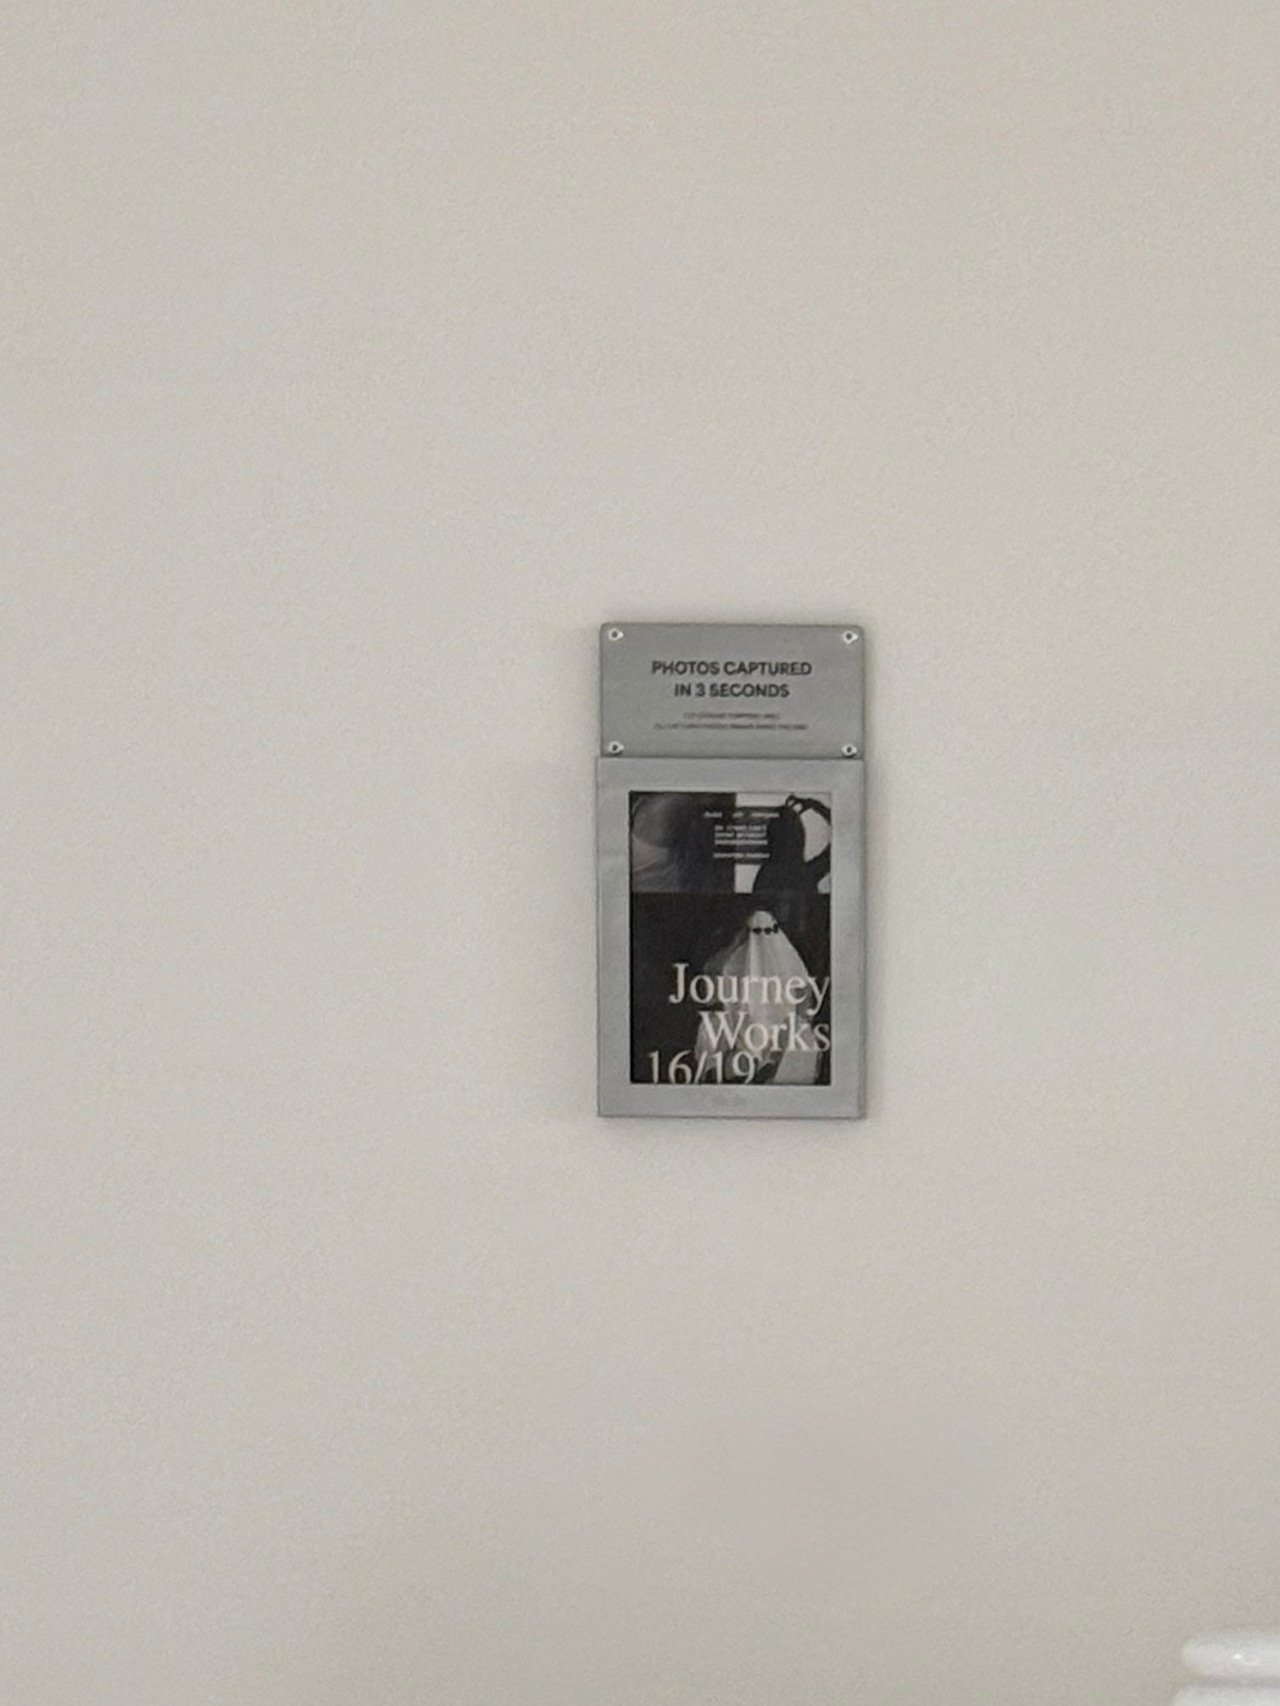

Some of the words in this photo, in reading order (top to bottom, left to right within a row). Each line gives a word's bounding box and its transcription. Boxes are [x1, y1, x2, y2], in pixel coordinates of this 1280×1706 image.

[652, 660, 720, 676] PHOTOS
[724, 660, 812, 676] CAPTURED
[674, 682, 692, 697] IN
[695, 683, 706, 698] 3
[710, 683, 790, 698] SECONDS
[669, 962, 830, 1016] Journey
[698, 1010, 831, 1051] Works
